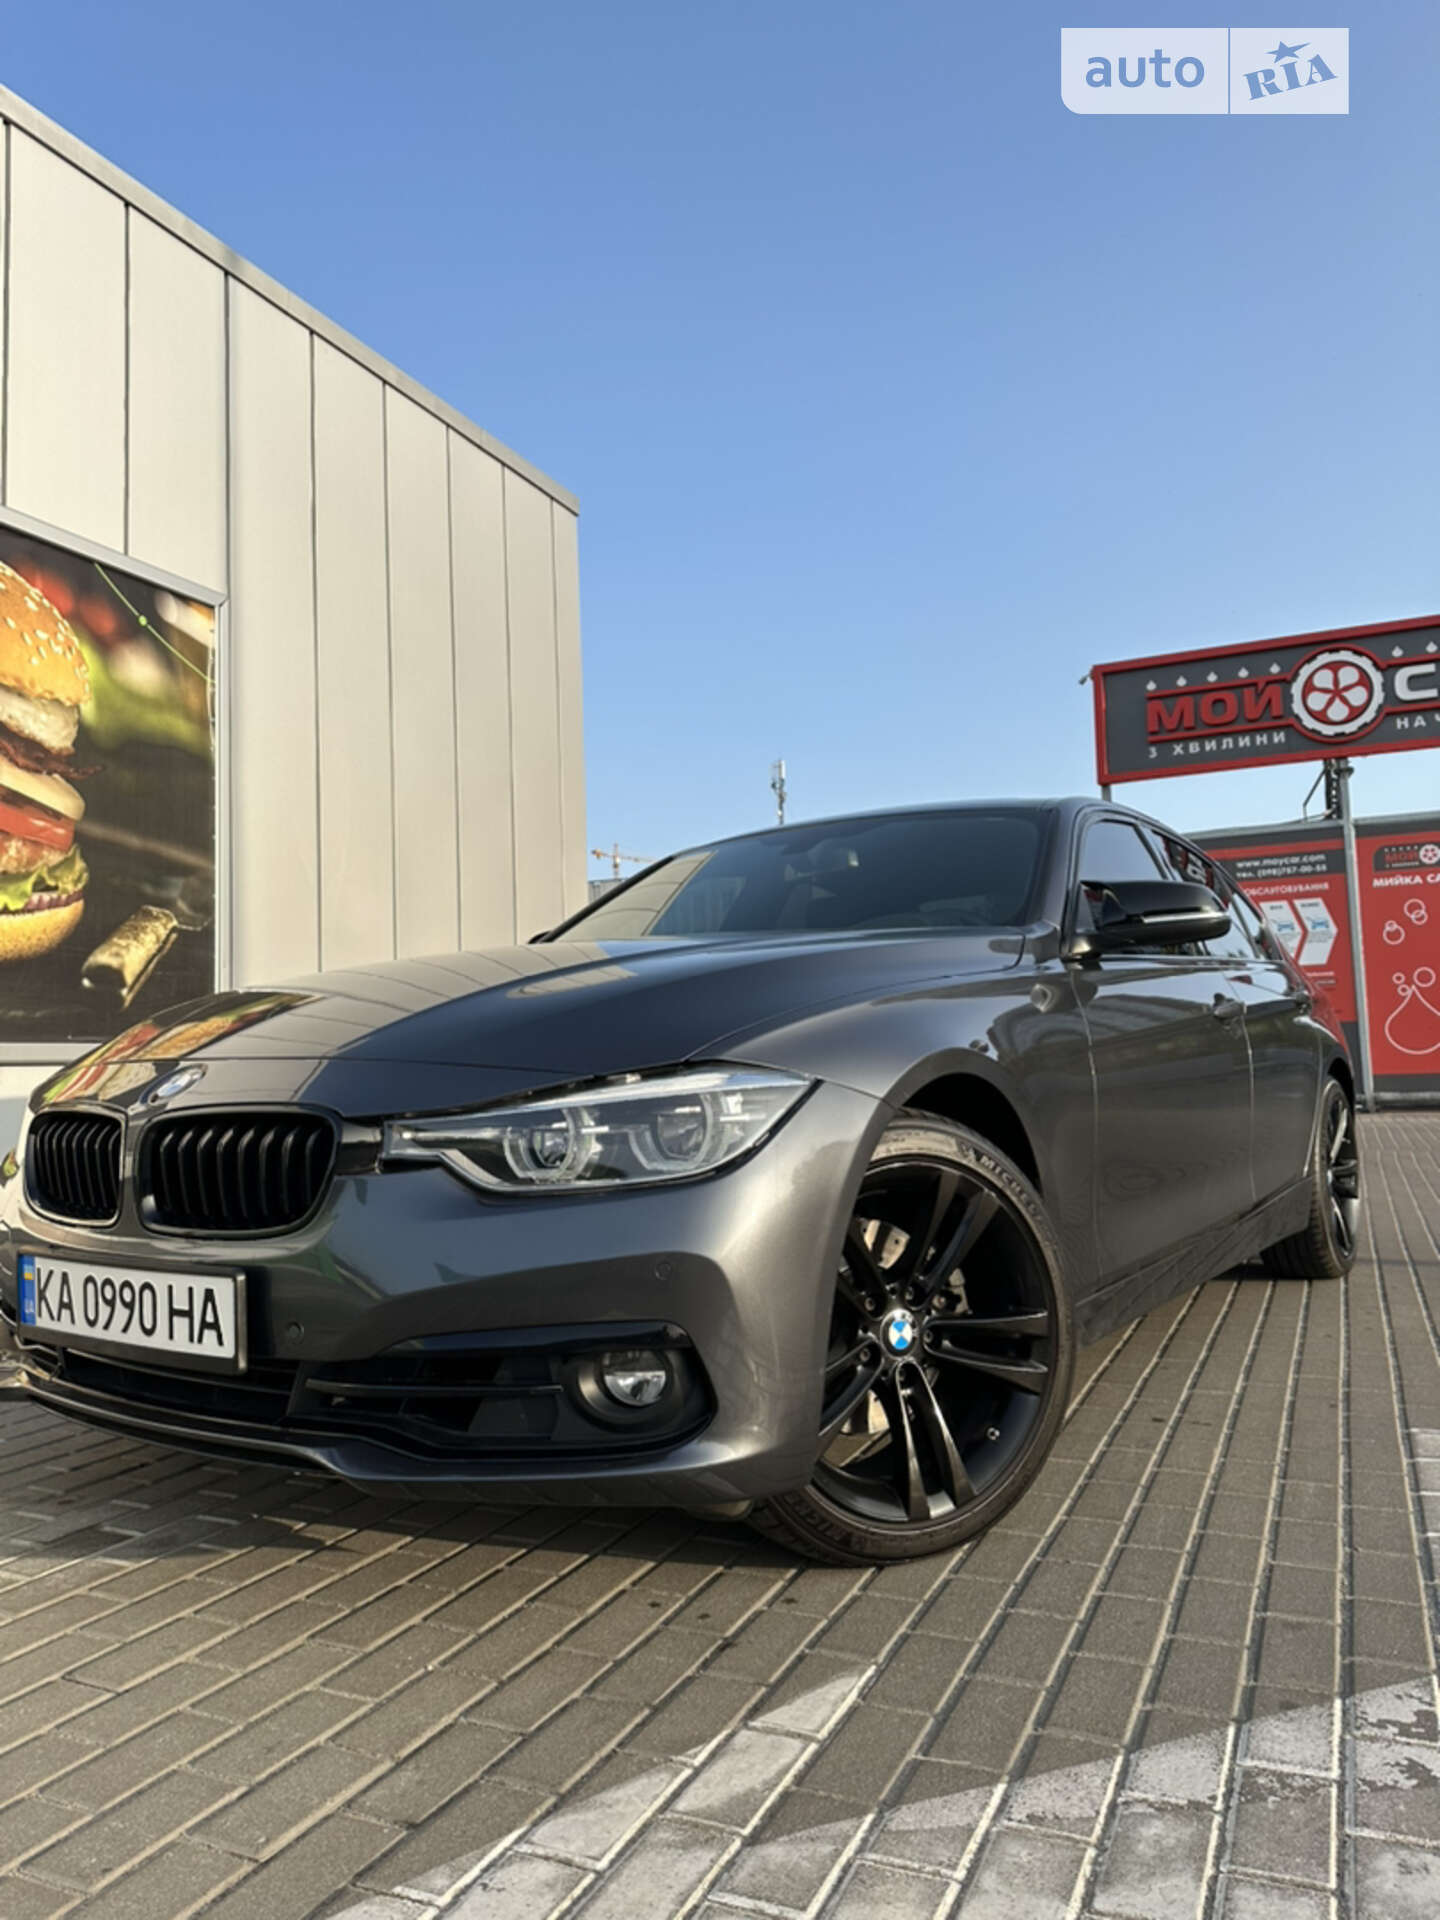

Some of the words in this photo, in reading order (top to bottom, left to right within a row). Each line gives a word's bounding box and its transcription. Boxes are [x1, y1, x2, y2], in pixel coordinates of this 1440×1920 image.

[1147, 682, 1284, 733] МОЙ
[1173, 732, 1286, 756] ХВИЛИНИ
[1372, 874, 1424, 888] МИЙКА
[37, 1267, 75, 1325] KA
[83, 1275, 157, 1337] 0990
[168, 1284, 224, 1347] HA
